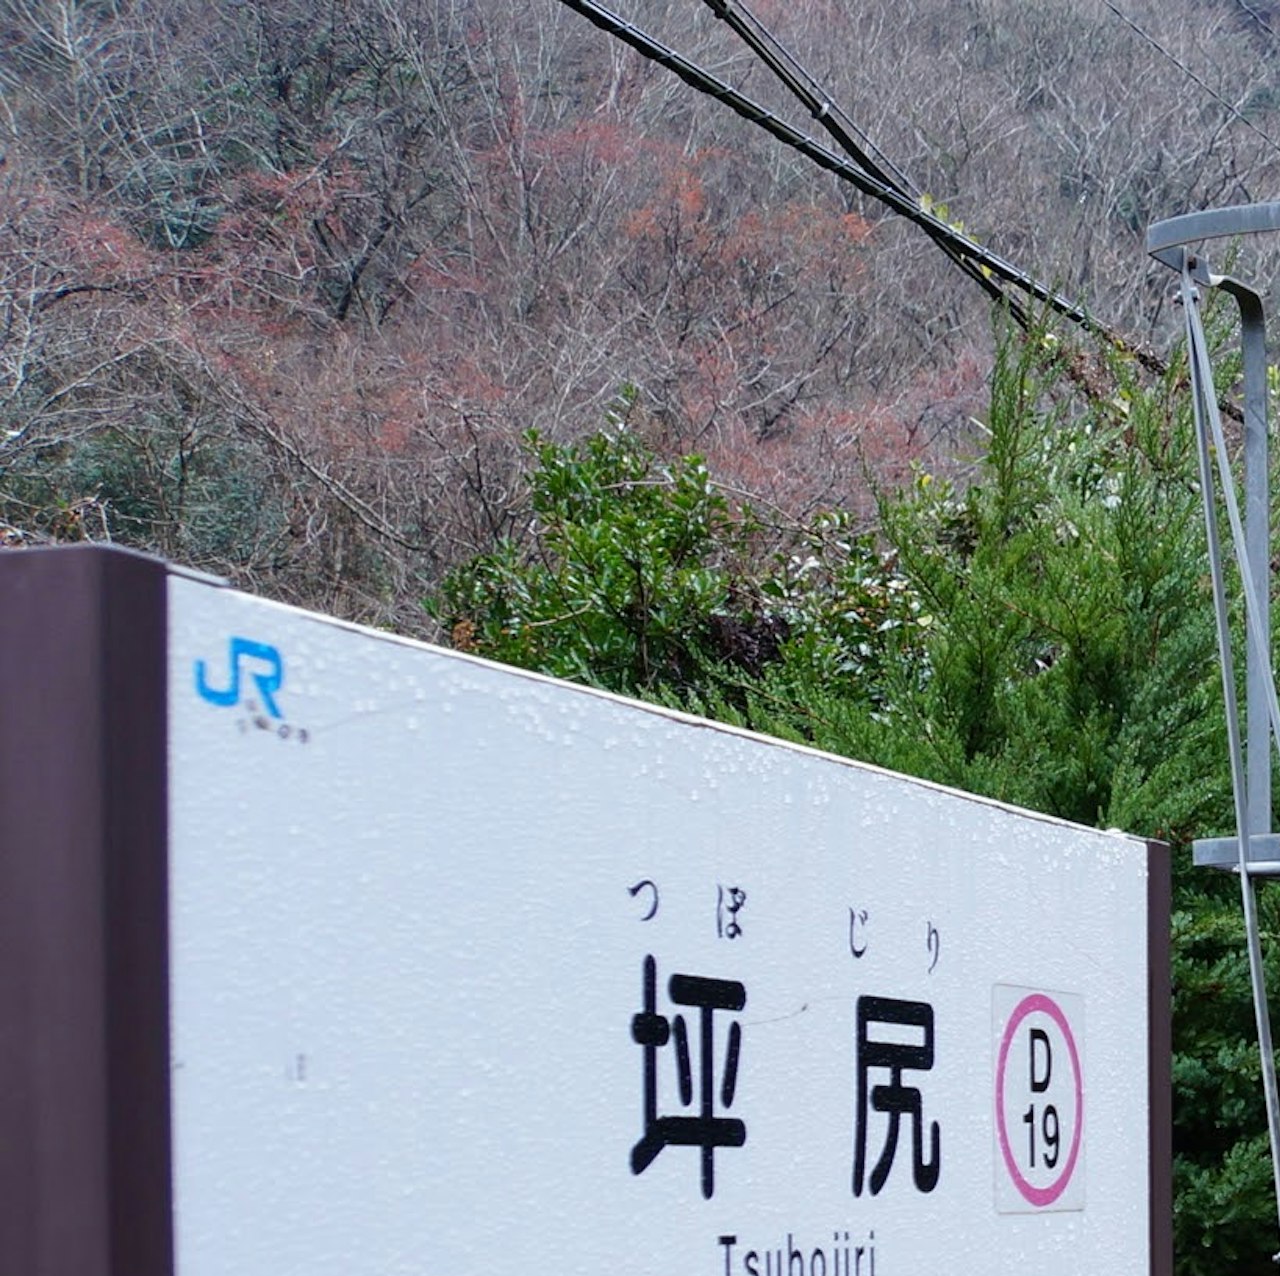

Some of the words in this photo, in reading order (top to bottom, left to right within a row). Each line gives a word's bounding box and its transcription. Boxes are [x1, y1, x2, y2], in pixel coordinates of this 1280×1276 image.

[195, 637, 283, 719] JR
[630, 954, 940, 1199] 坪尻
[1029, 1028, 1052, 1094] D
[1022, 1103, 1061, 1169] 19
